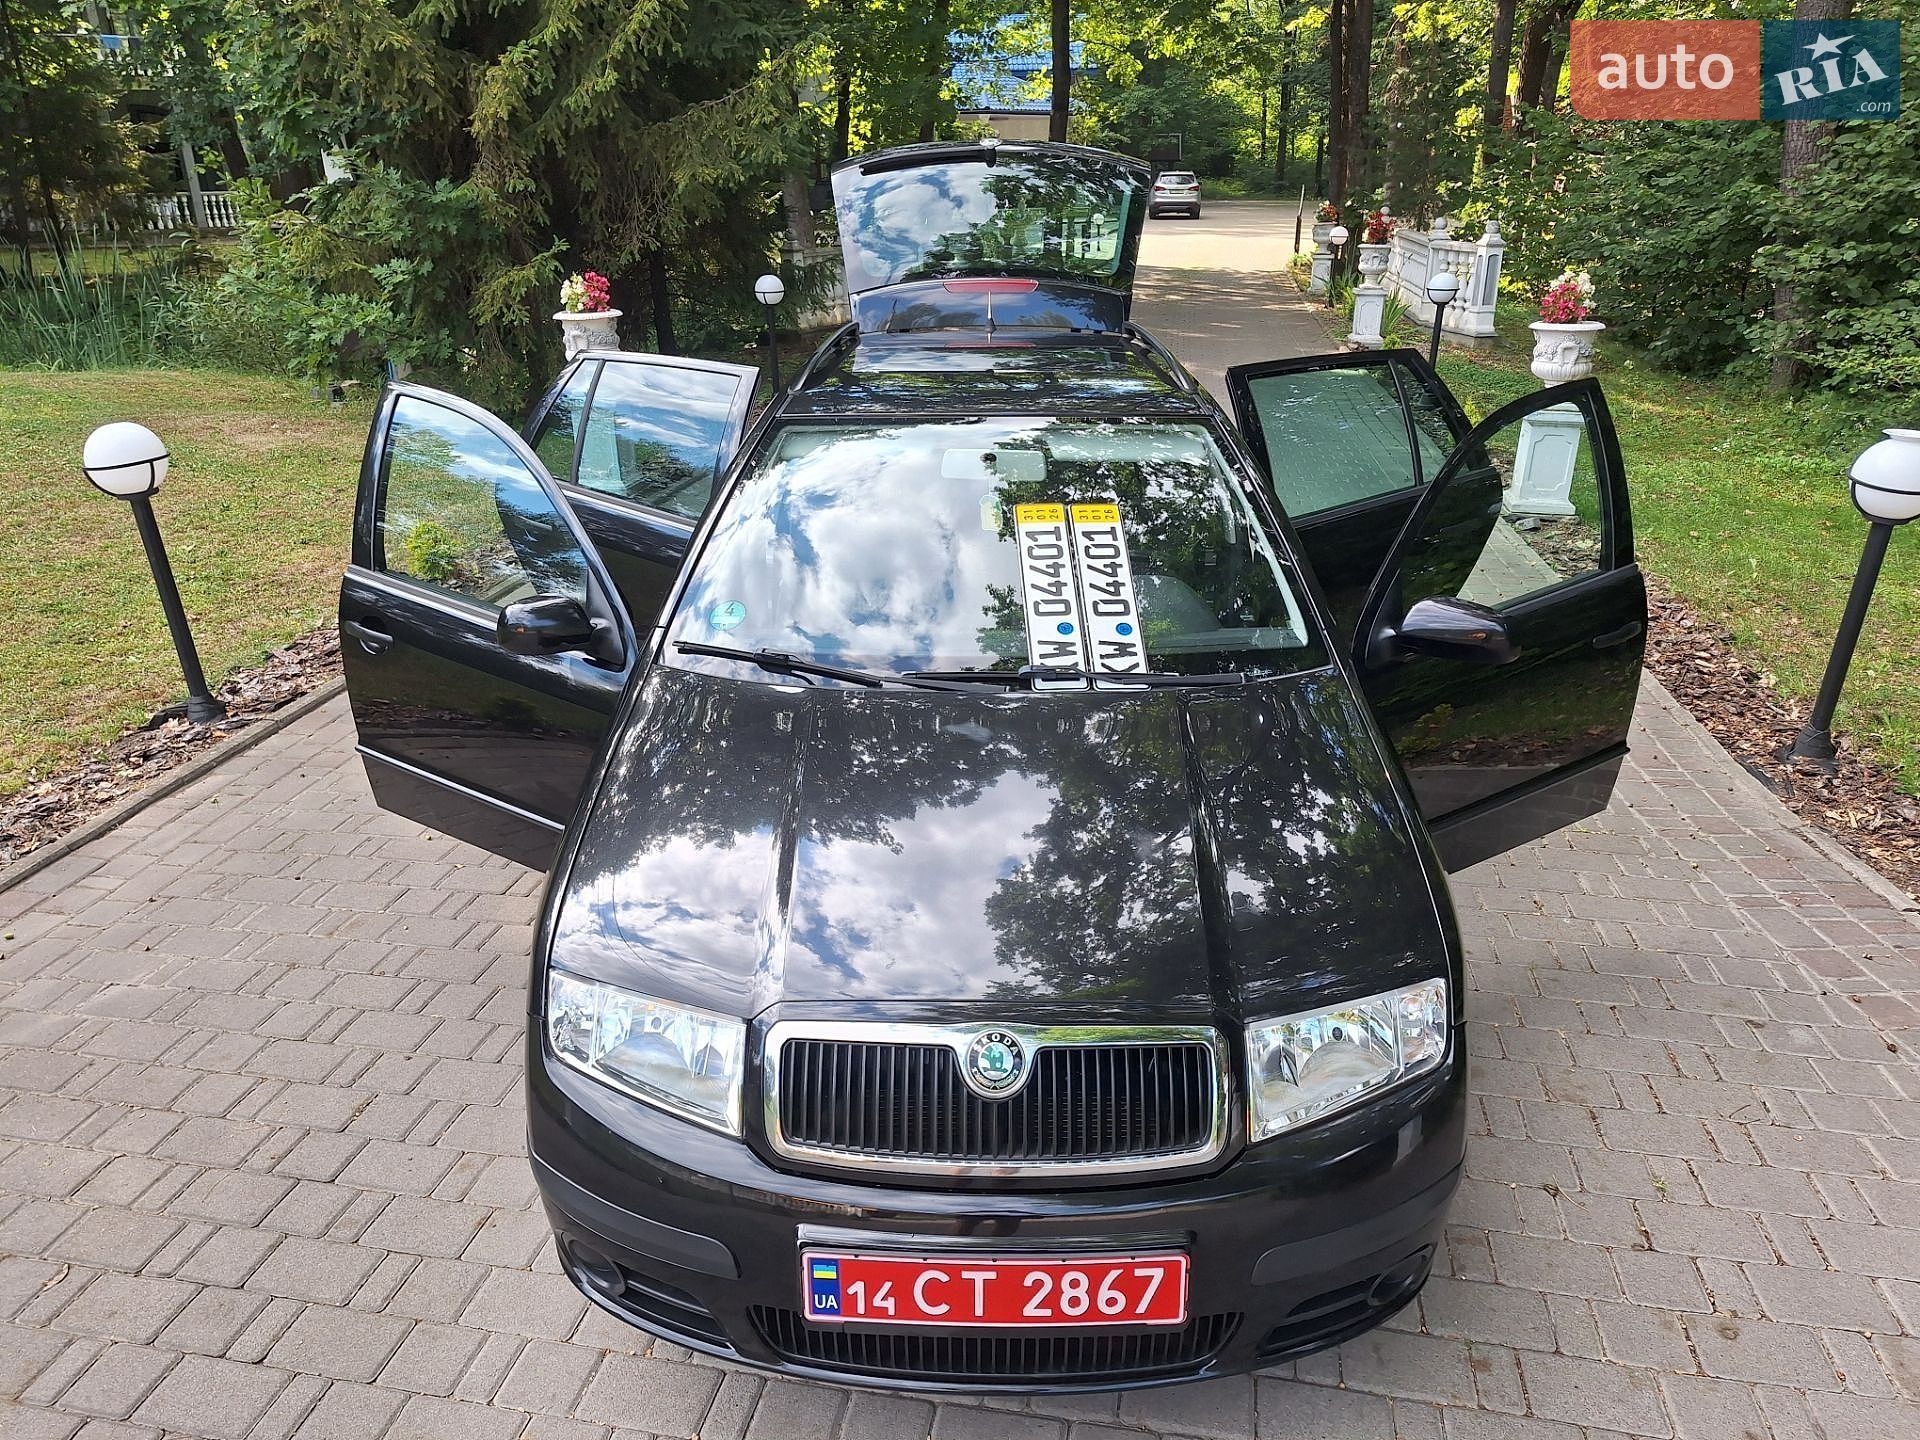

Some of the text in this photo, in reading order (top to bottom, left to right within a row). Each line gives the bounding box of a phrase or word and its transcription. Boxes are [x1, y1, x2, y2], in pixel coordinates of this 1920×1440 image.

[1024, 508, 1034, 520] 31
[1037, 508, 1047, 520] 01
[1079, 508, 1089, 520] 31
[1092, 508, 1102, 520] 01
[1104, 508, 1115, 520] 26
[1025, 526, 1072, 616] 04401
[1081, 526, 1131, 616] 04401
[724, 601, 735, 616] 4
[846, 1267, 1164, 1317] 14 CT 2867
[814, 1294, 838, 1309] UA
